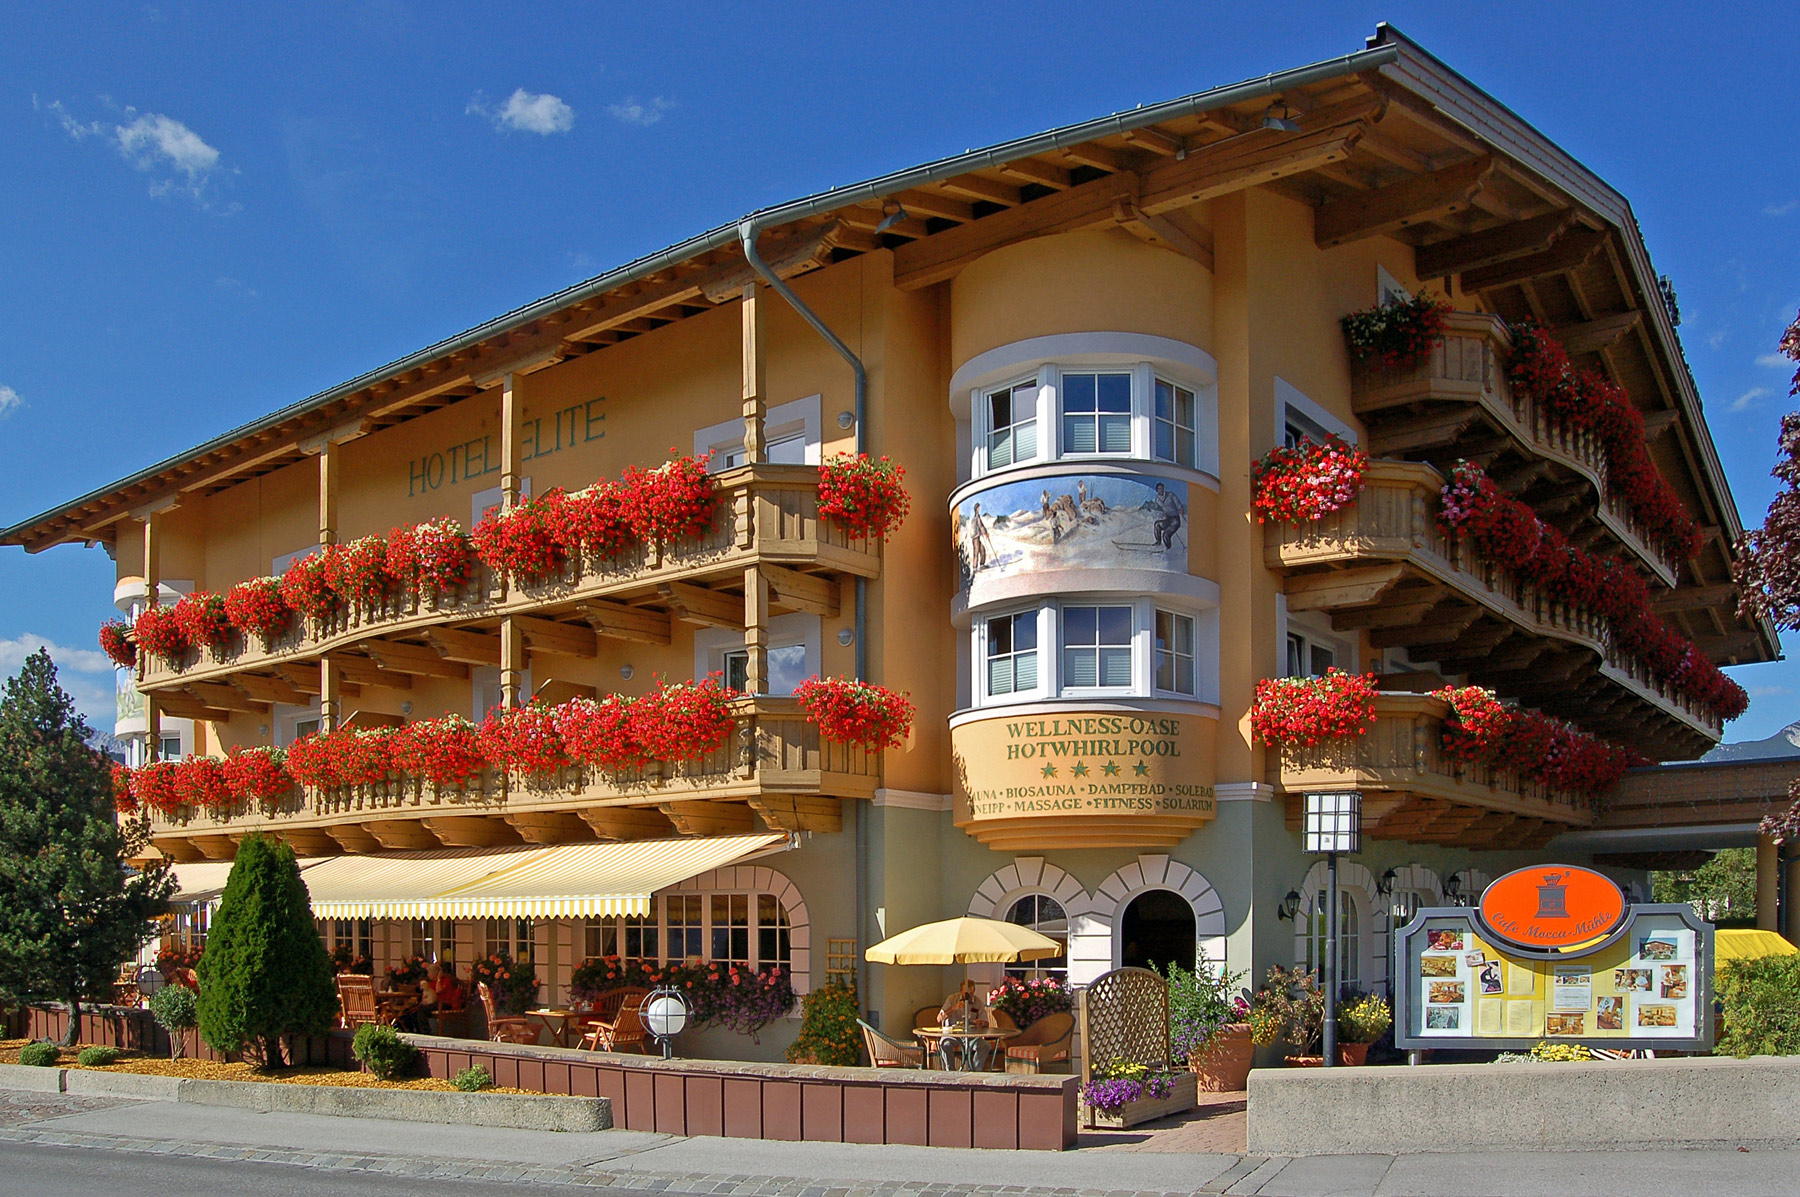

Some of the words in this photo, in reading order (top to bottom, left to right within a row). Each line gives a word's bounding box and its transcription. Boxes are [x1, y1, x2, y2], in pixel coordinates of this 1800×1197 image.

[407, 435, 502, 497] HOTEL
[1006, 717, 1181, 739] WELLNESS-OASE
[1007, 739, 1182, 760] HOTWHIRLPOOL
[1006, 784, 1077, 799] BIOSAUNA
[1087, 783, 1166, 796] DAMPFBAD
[1175, 783, 1214, 798] SOLEBAD
[1014, 798, 1083, 812] MASSAGE
[1094, 797, 1153, 810] FITNESS
[1162, 797, 1213, 812] SOLARIUM
[1521, 911, 1613, 939] Mocca-Mühle
